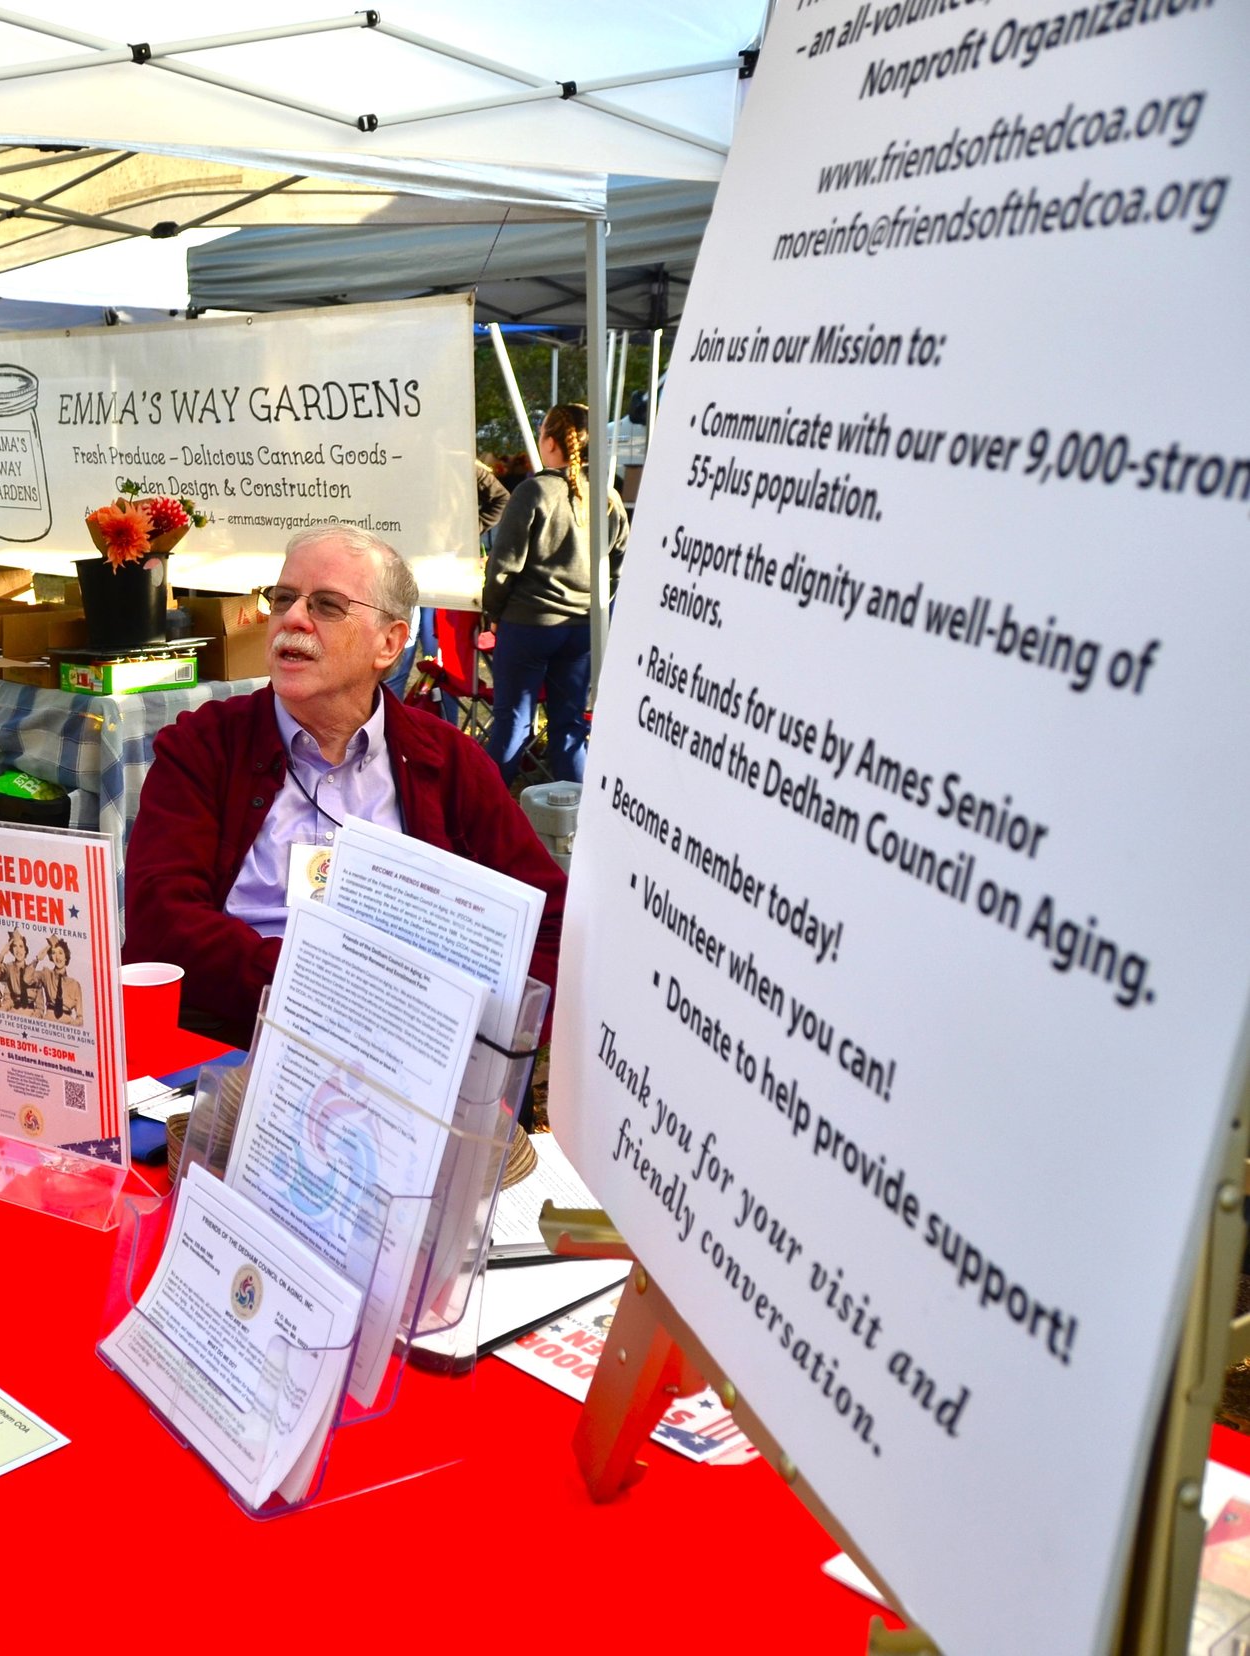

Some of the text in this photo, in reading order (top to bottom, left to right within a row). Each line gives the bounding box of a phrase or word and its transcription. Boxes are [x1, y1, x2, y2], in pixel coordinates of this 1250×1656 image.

[808, 25, 836, 58] an
[859, 28, 988, 99] Nonprofit
[818, 89, 1207, 193] www.friendsofthedcoa.org
[773, 175, 1231, 261] moreinfo@friendsofthedcoa.org
[690, 323, 947, 367] Join us in our Mission to:
[58, 378, 420, 424] EMMA'S WAY GARDENS
[72, 443, 387, 466] Fresh Produce Delicious Canned Goods
[701, 402, 1250, 501] Communicate with our over 9,000-stron
[115, 475, 351, 500] Gden Design & Construction
[687, 453, 883, 521] 55-plus population.
[660, 582, 723, 629] seniors.
[671, 525, 1162, 696] Support the dignity and well-being of
[646, 645, 1049, 859] Raise funds for use by Ames Senior
[19, 858, 79, 893] DOOR
[612, 777, 844, 964] Become a member today!
[638, 695, 1156, 1010] Center and the Dedham Council on Aging.
[21, 922, 30, 930] TO
[32, 925, 47, 933] OUR
[49, 928, 87, 940] VETERANS
[643, 875, 897, 1103] Volunteer when you can!
[4, 1020, 14, 1028] THE
[16, 1023, 40, 1033] DEDHAM
[41, 1028, 66, 1039] COUNCIL
[77, 1036, 96, 1045] AGING
[6, 1012, 47, 1027] PERFORMANCE
[49, 1020, 81, 1035] PRESENTED
[17, 1040, 38, 1053] 30TH
[43, 1046, 76, 1062] 6:30PM
[14, 1053, 37, 1064] Eastern
[38, 1057, 58, 1070] Avenue
[59, 1062, 84, 1076] Dedham,
[666, 975, 1078, 1367] Donate to help provide support!
[202, 1215, 222, 1236] FRIENDS
[221, 1231, 229, 1240] OF
[228, 1236, 239, 1249] THE
[238, 1245, 259, 1265] DEDHAM
[257, 1262, 279, 1283] COUNCIL
[278, 1278, 287, 1289] ON
[598, 1021, 972, 1438] Thank you for your visit and
[612, 1118, 882, 1458] friendly conversation.
[515, 1331, 599, 1380] DOOR
[14, 1421, 30, 1434] COA
